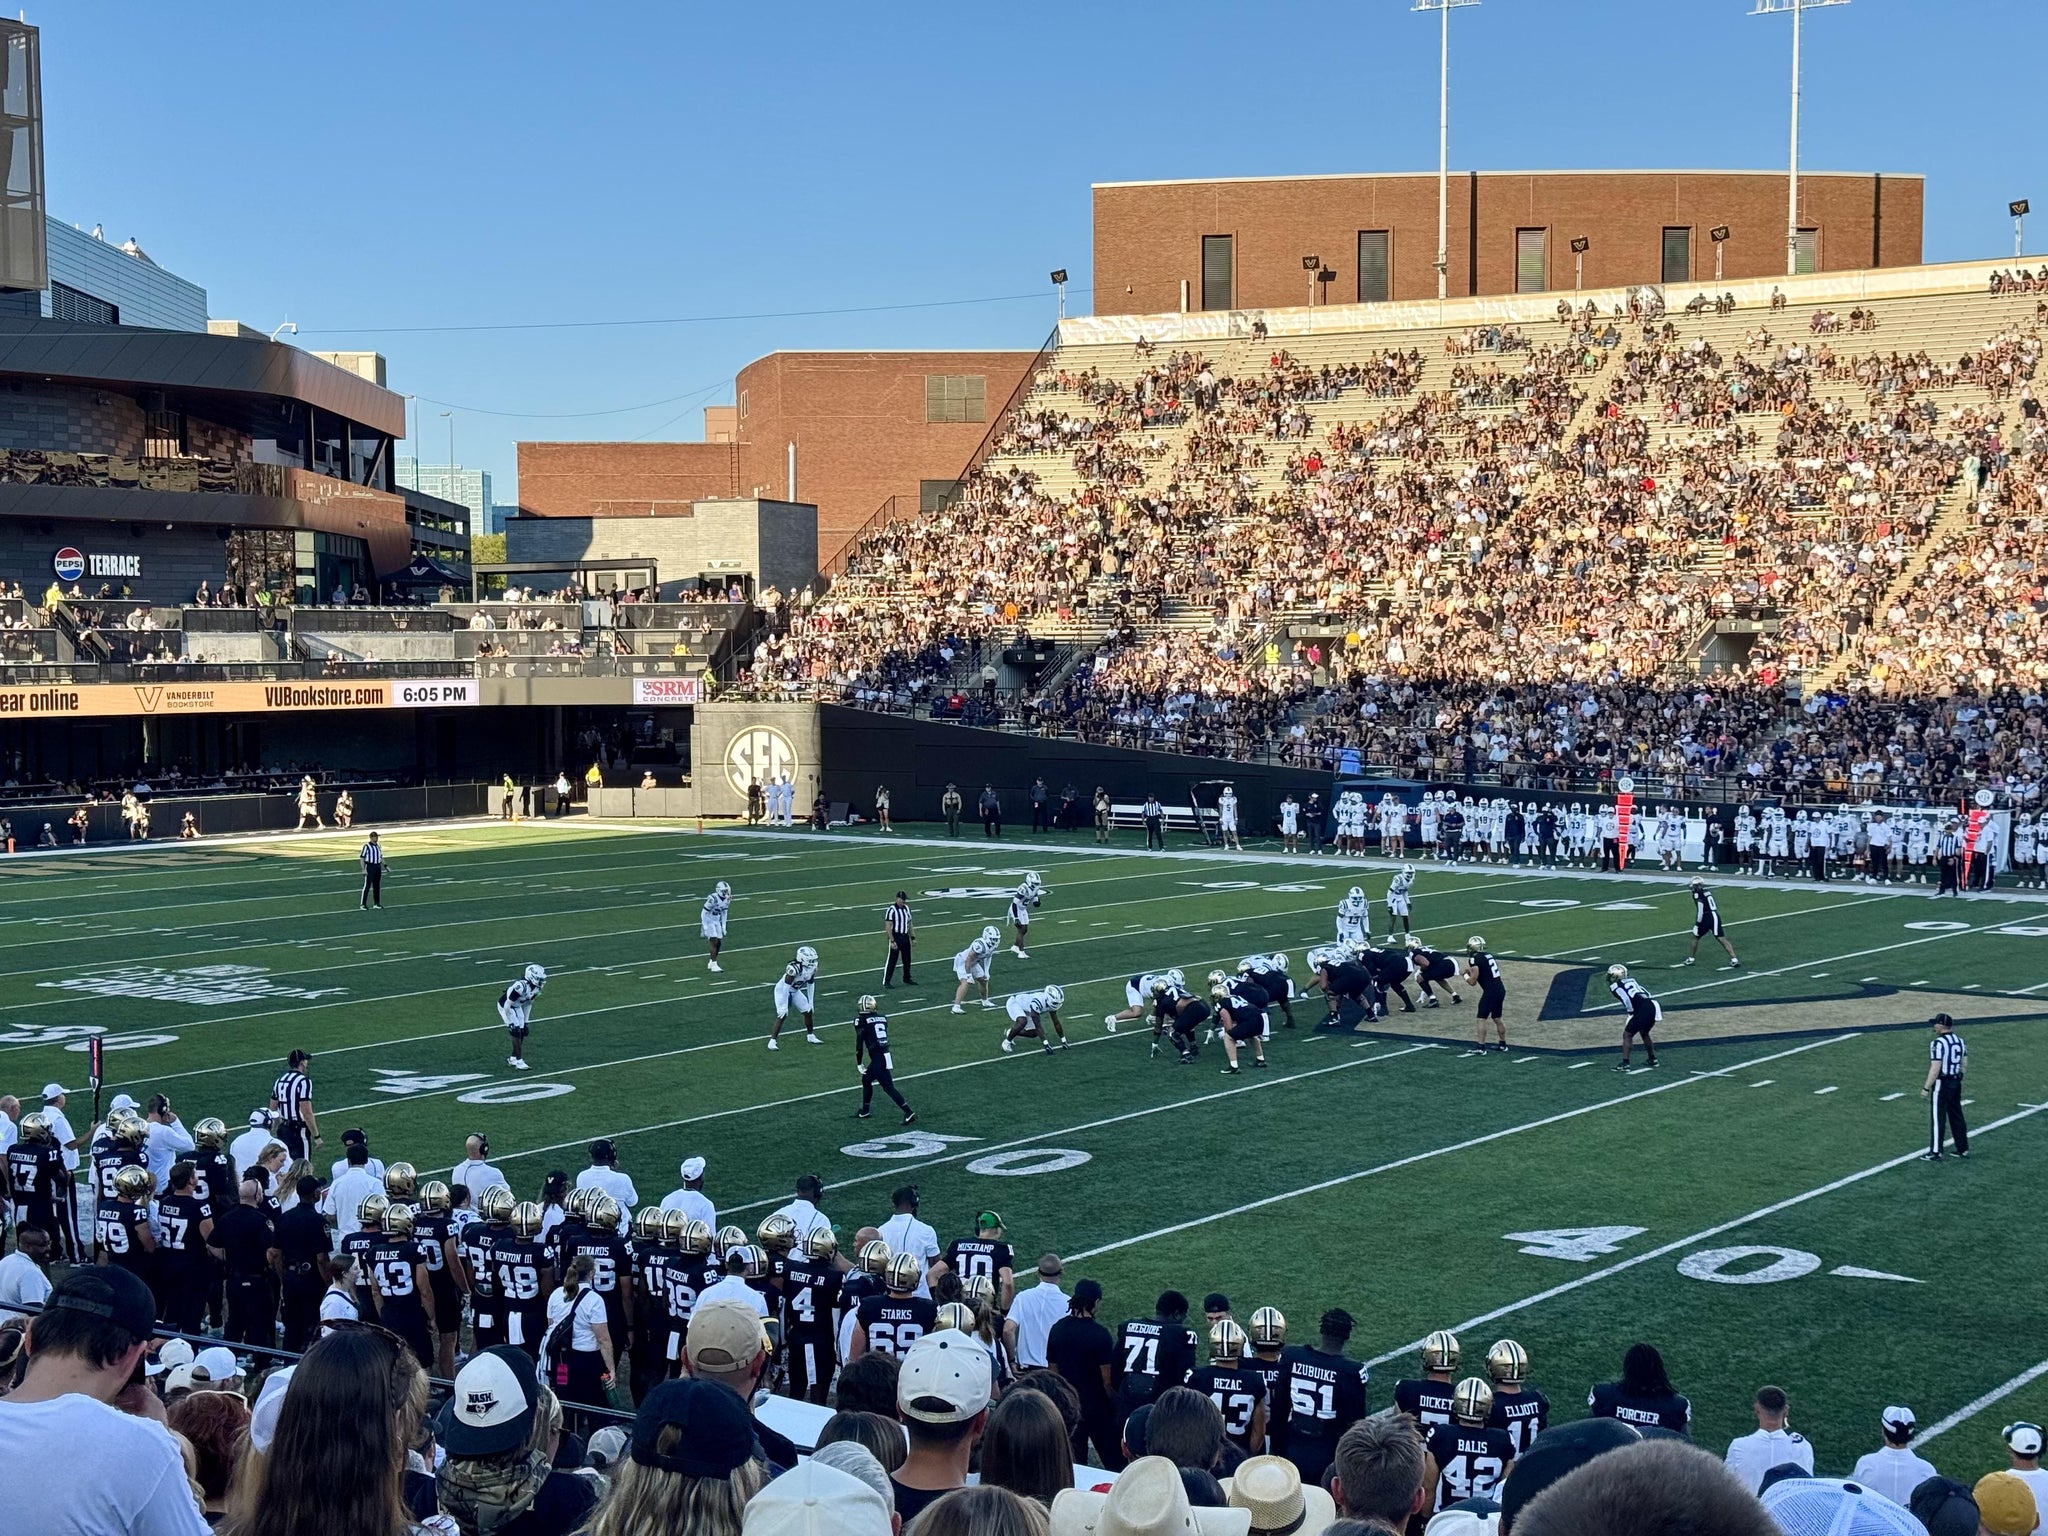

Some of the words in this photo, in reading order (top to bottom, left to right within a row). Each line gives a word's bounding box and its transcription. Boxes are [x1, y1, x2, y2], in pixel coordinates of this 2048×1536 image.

[56, 560, 82, 568] PEPSI
[89, 554, 141, 577] TERRACE
[166, 691, 215, 700] VANDERBILT
[264, 686, 384, 707] VUBookstore.com
[403, 687, 438, 702] 6:05
[443, 686, 467, 701] PM
[652, 681, 696, 696] SRM
[30, 688, 79, 712] online
[167, 700, 215, 709] BOOKSTORE
[730, 731, 792, 795] SEC
[1488, 958, 1500, 979] 2
[1950, 1044, 1961, 1064] C
[278, 1082, 290, 1102] H
[48, 1150, 58, 1162] 17
[839, 1130, 1093, 1176] 50
[10, 1163, 38, 1193] 17
[157, 1215, 189, 1250] 57
[577, 1245, 610, 1257] EDWARDS
[956, 1242, 995, 1254] MUSCHAMP
[1501, 1225, 1823, 1285] 40
[955, 1253, 993, 1283] 10
[373, 1261, 415, 1296] 43
[498, 1264, 540, 1300] 48
[814, 1276, 826, 1287] JR
[791, 1286, 815, 1322] 4
[880, 1308, 913, 1320] STARKS
[1126, 1322, 1163, 1336] GREGOIRE
[868, 1322, 924, 1360] 69
[1123, 1335, 1160, 1375] 71
[1291, 1361, 1338, 1383] AZUBUIKE
[1213, 1377, 1243, 1391] REZAC
[467, 1392, 493, 1404] NASH
[1290, 1377, 1337, 1420] 51
[1419, 1395, 1454, 1411] DICKEY
[1504, 1401, 1540, 1418] ELLIOTT
[1615, 1405, 1660, 1425] PORCHER
[1457, 1438, 1488, 1454] BALIS
[1441, 1454, 1504, 1499] 42
